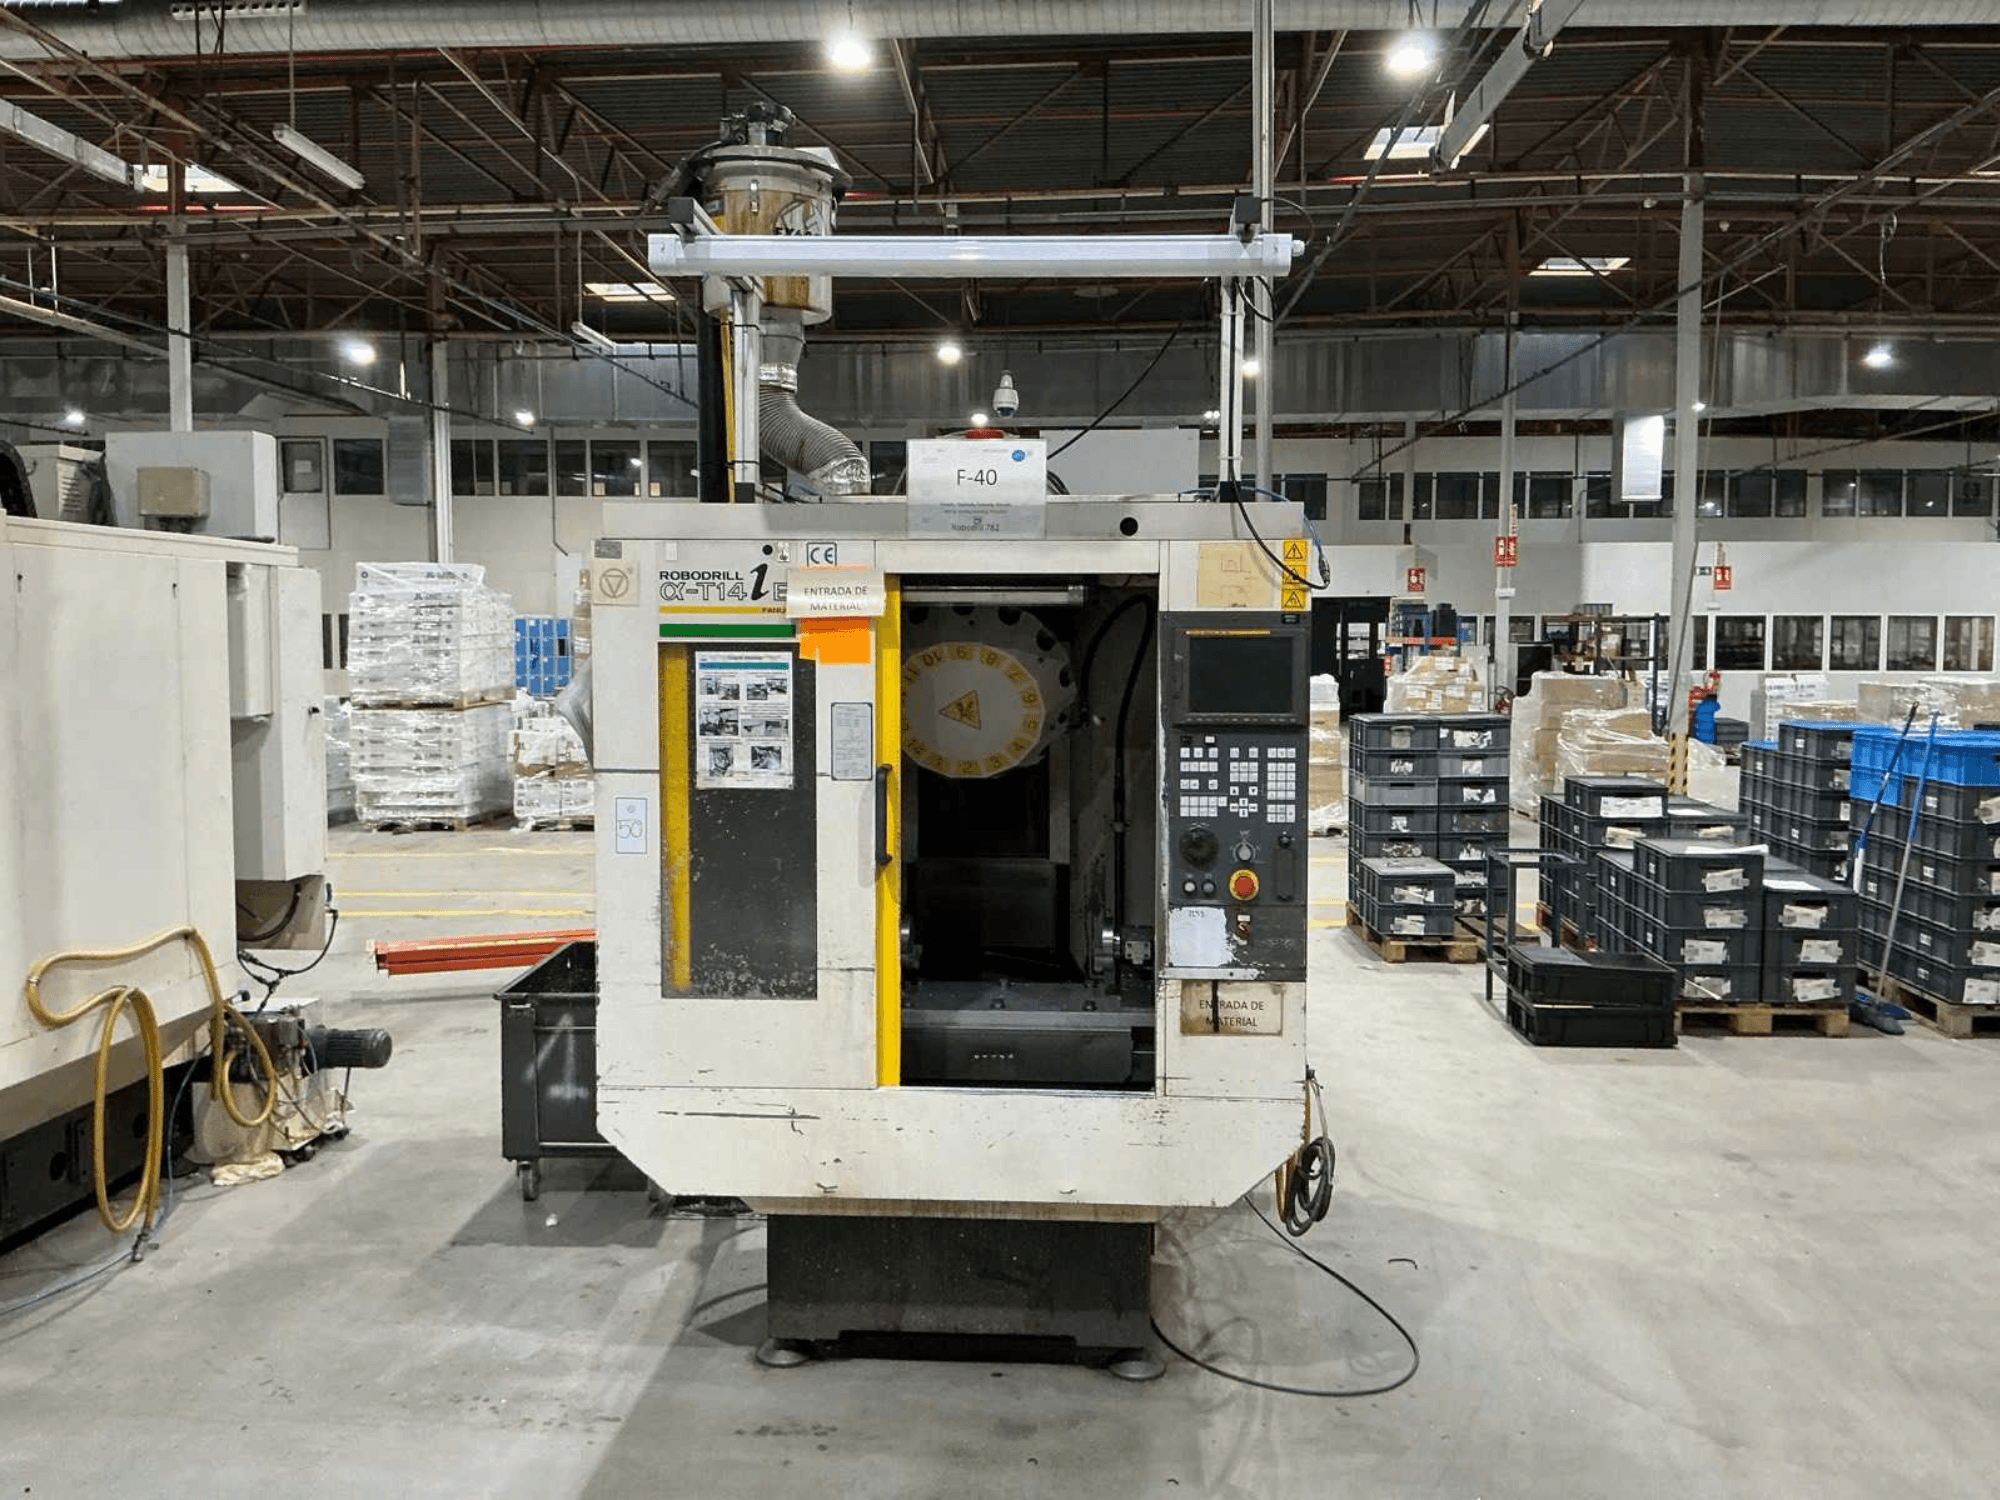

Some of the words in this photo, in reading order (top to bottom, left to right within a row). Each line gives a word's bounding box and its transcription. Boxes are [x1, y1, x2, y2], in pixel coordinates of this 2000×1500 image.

[956, 469, 998, 486] F-40
[809, 547, 834, 564] CE
[659, 570, 744, 581] ROBODRILL
[804, 586, 852, 596] ENTRADA
[854, 585, 868, 595] DE
[761, 606, 787, 614] FANU
[810, 600, 862, 611] MATERIAL
[1199, 999, 1249, 1010] ENRADA
[1250, 1000, 1265, 1011] DE
